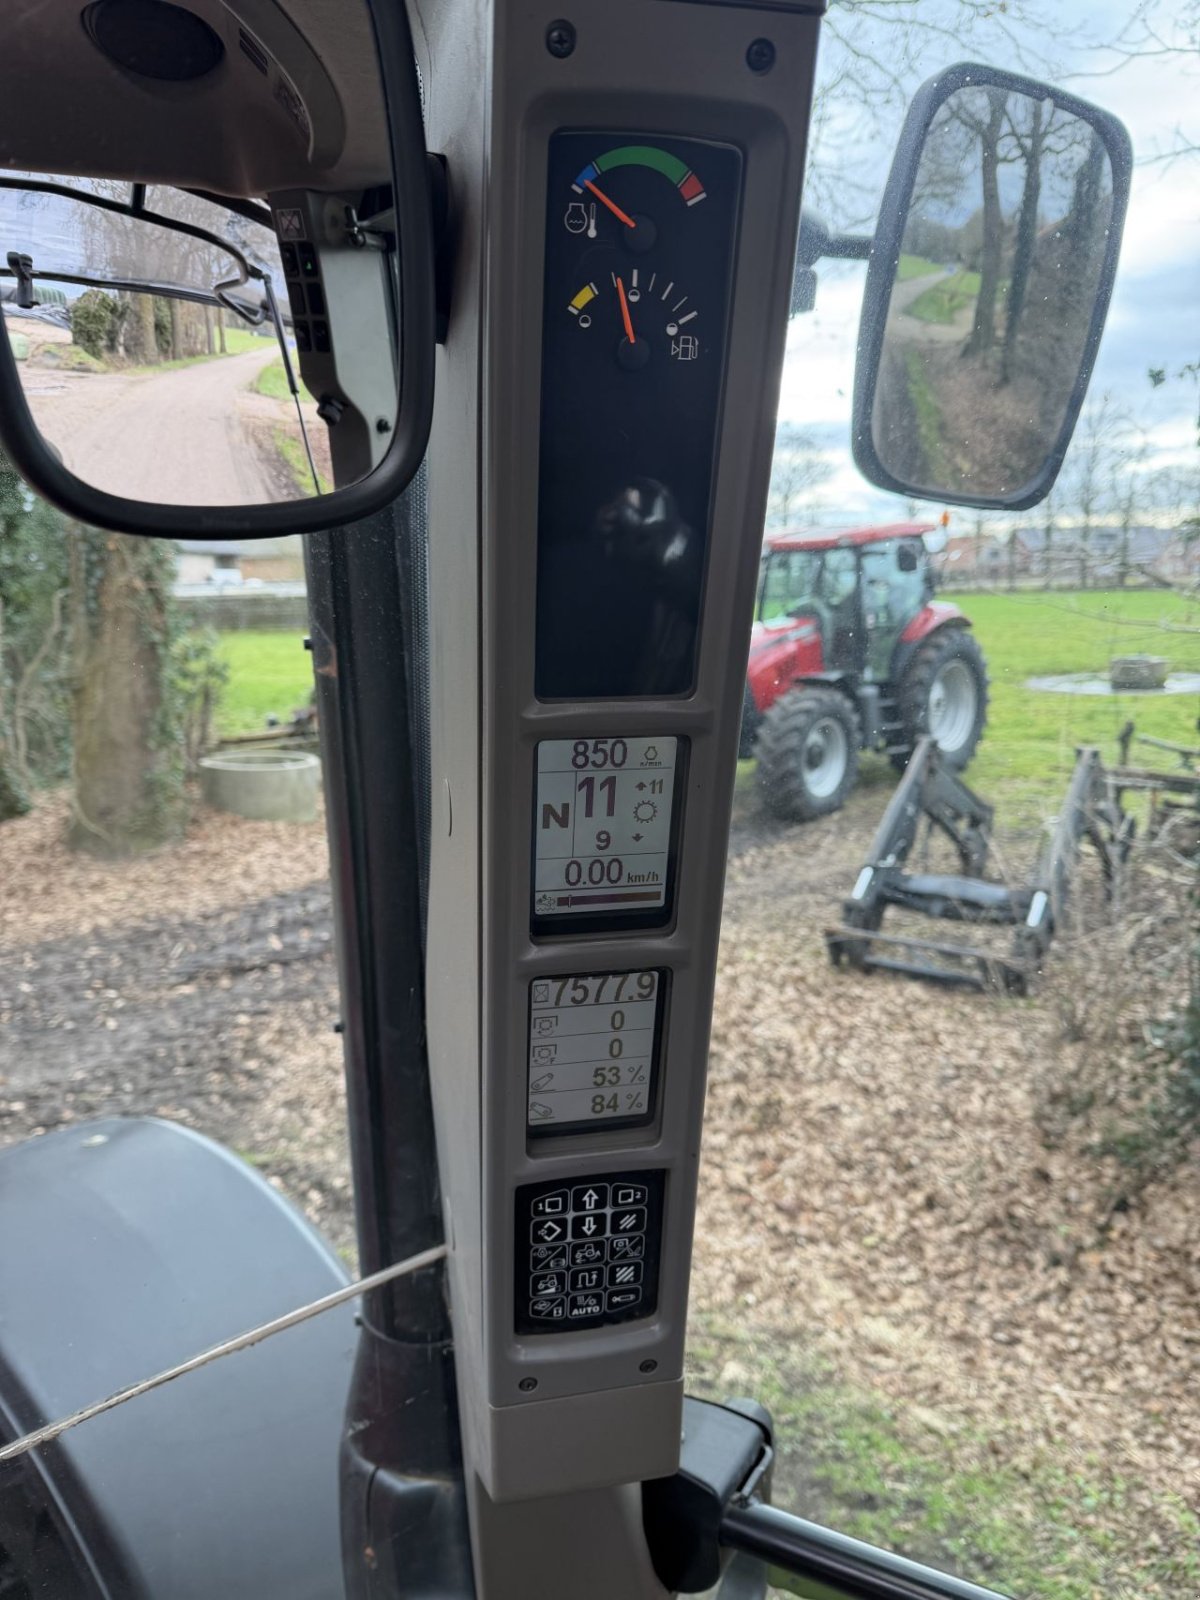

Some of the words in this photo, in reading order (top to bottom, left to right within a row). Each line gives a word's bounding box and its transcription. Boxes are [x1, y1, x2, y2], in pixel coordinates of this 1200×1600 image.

[571, 739, 628, 769] 850
[577, 775, 617, 818] 11
[649, 779, 663, 794] 11
[542, 803, 570, 829] N
[596, 830, 611, 850] 9
[565, 858, 623, 886] 0.00
[627, 871, 659, 884] km/h
[551, 972, 655, 1006] 7577.9
[610, 1010, 625, 1030] 0
[609, 1038, 623, 1058] 0
[592, 1066, 621, 1087] 53
[591, 1093, 619, 1114] 84
[571, 1306, 600, 1316] AUTO
